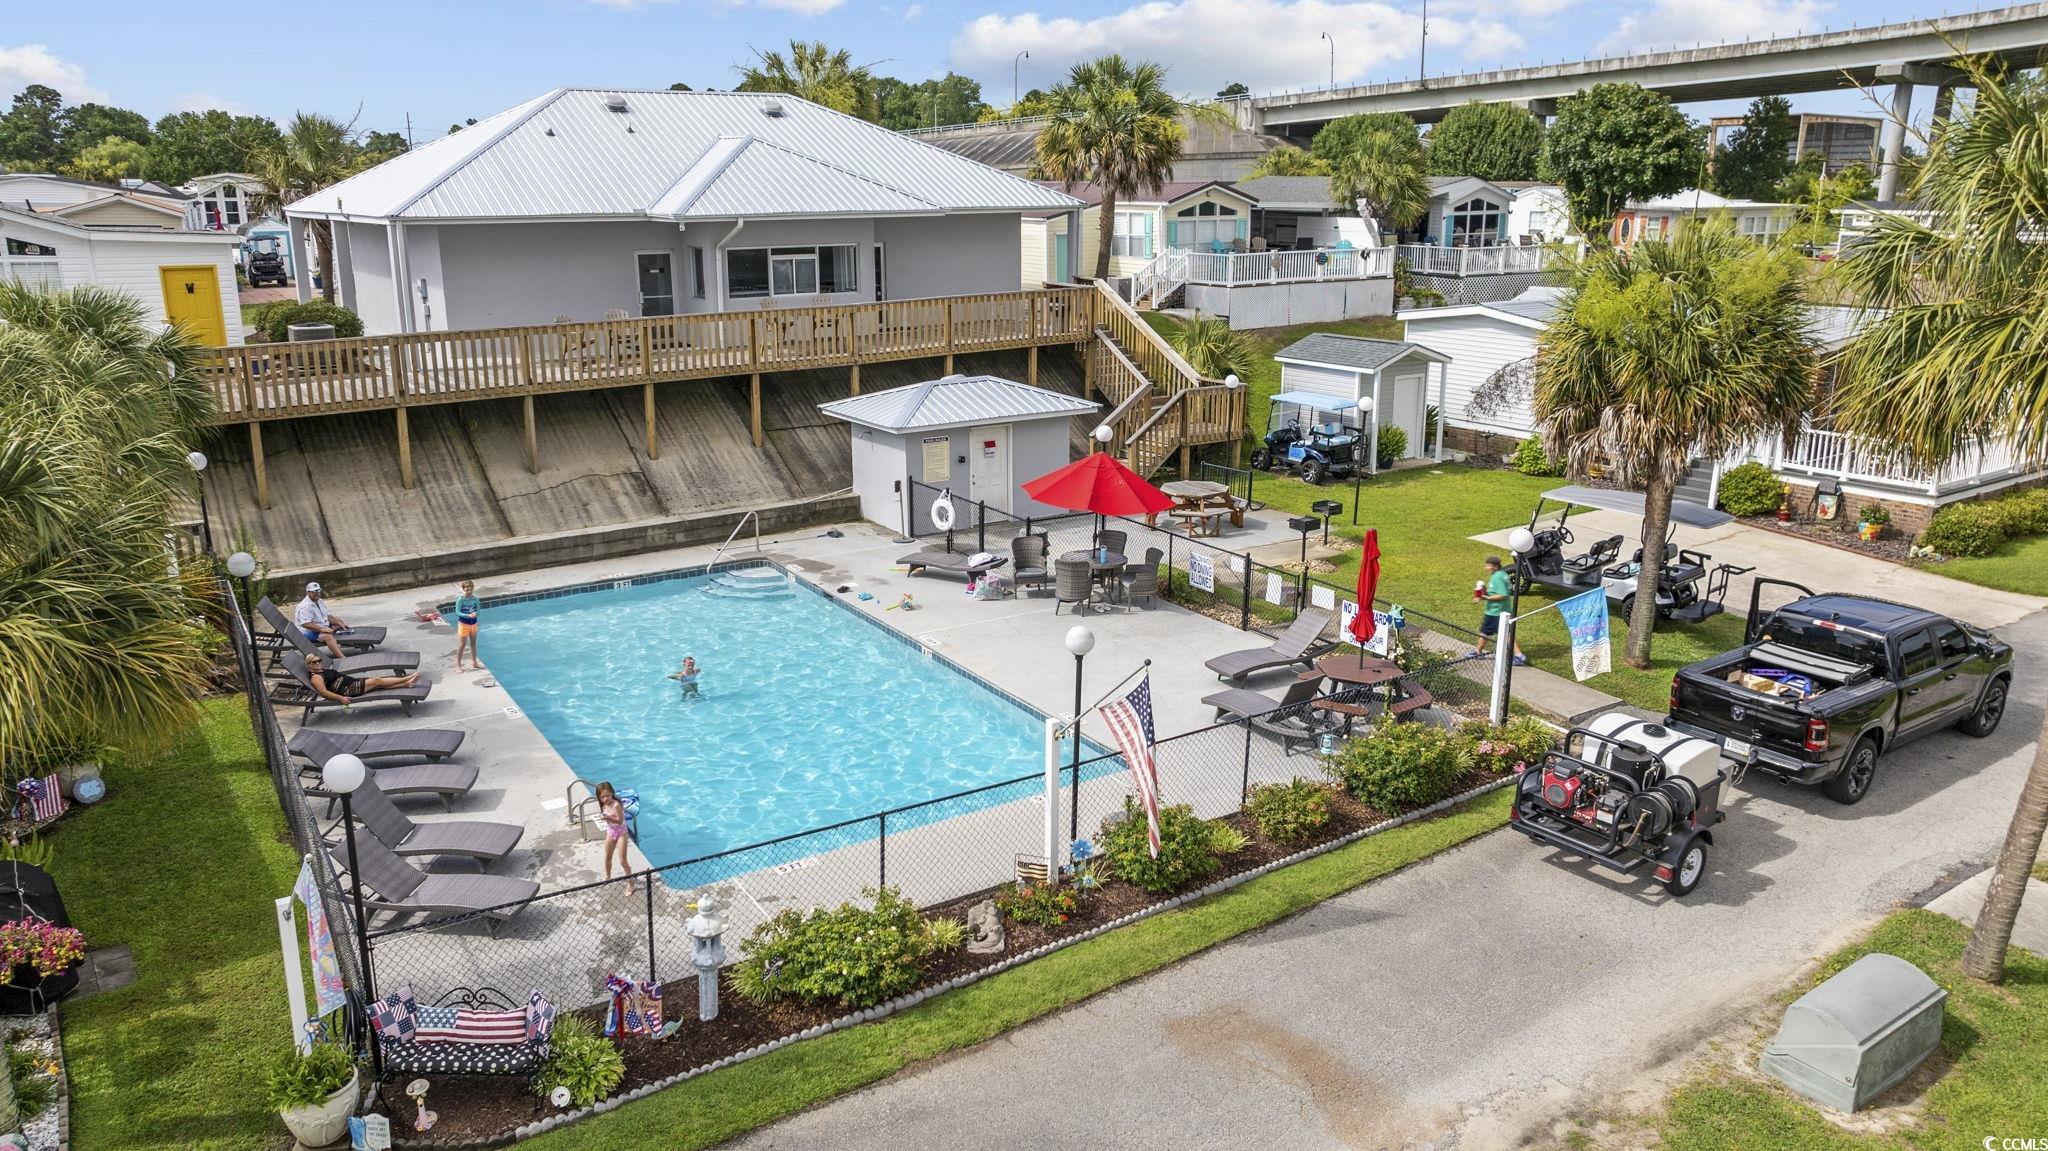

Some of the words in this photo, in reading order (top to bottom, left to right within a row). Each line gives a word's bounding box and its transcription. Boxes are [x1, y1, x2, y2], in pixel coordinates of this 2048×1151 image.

[1191, 571, 1212, 589] ALLOWED
[1343, 601, 1353, 614] NO
[1371, 635, 1384, 646] OUR
